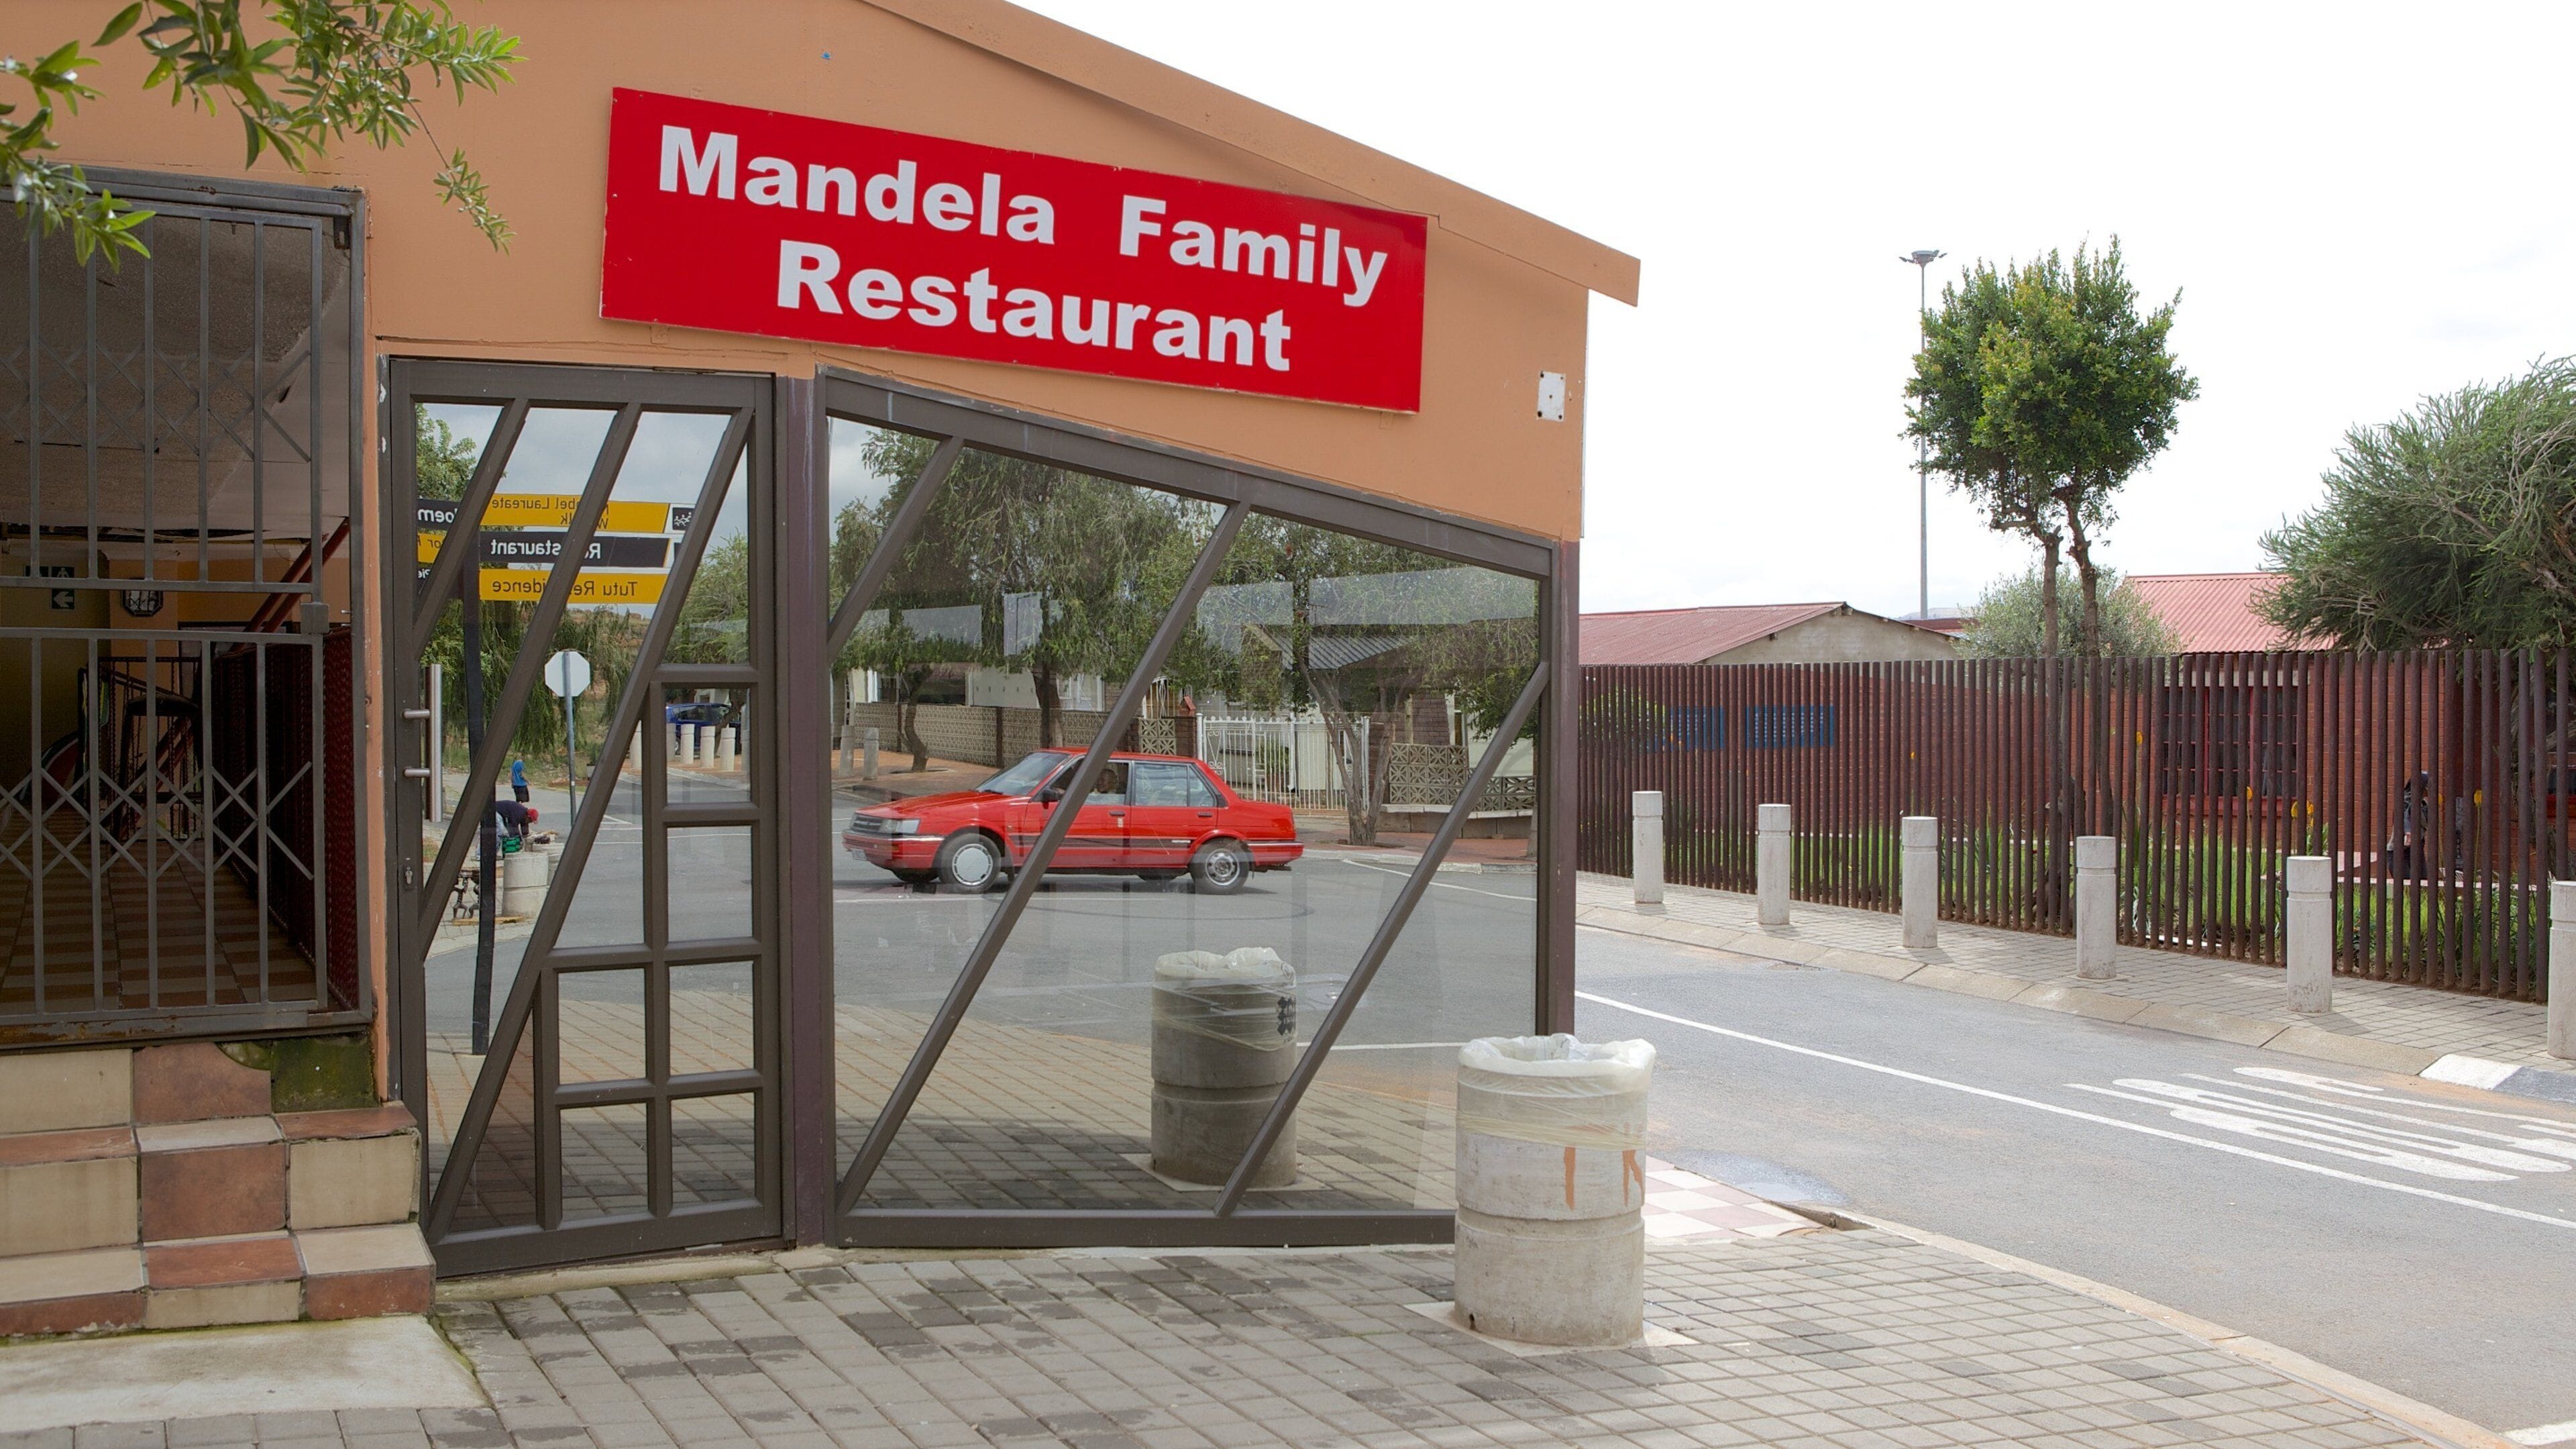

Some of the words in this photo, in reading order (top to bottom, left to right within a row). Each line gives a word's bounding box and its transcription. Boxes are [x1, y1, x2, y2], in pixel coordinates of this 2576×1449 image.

[659, 125, 1054, 244] Mandela
[1120, 195, 1387, 307] Family
[778, 239, 1291, 372] Restaurant
